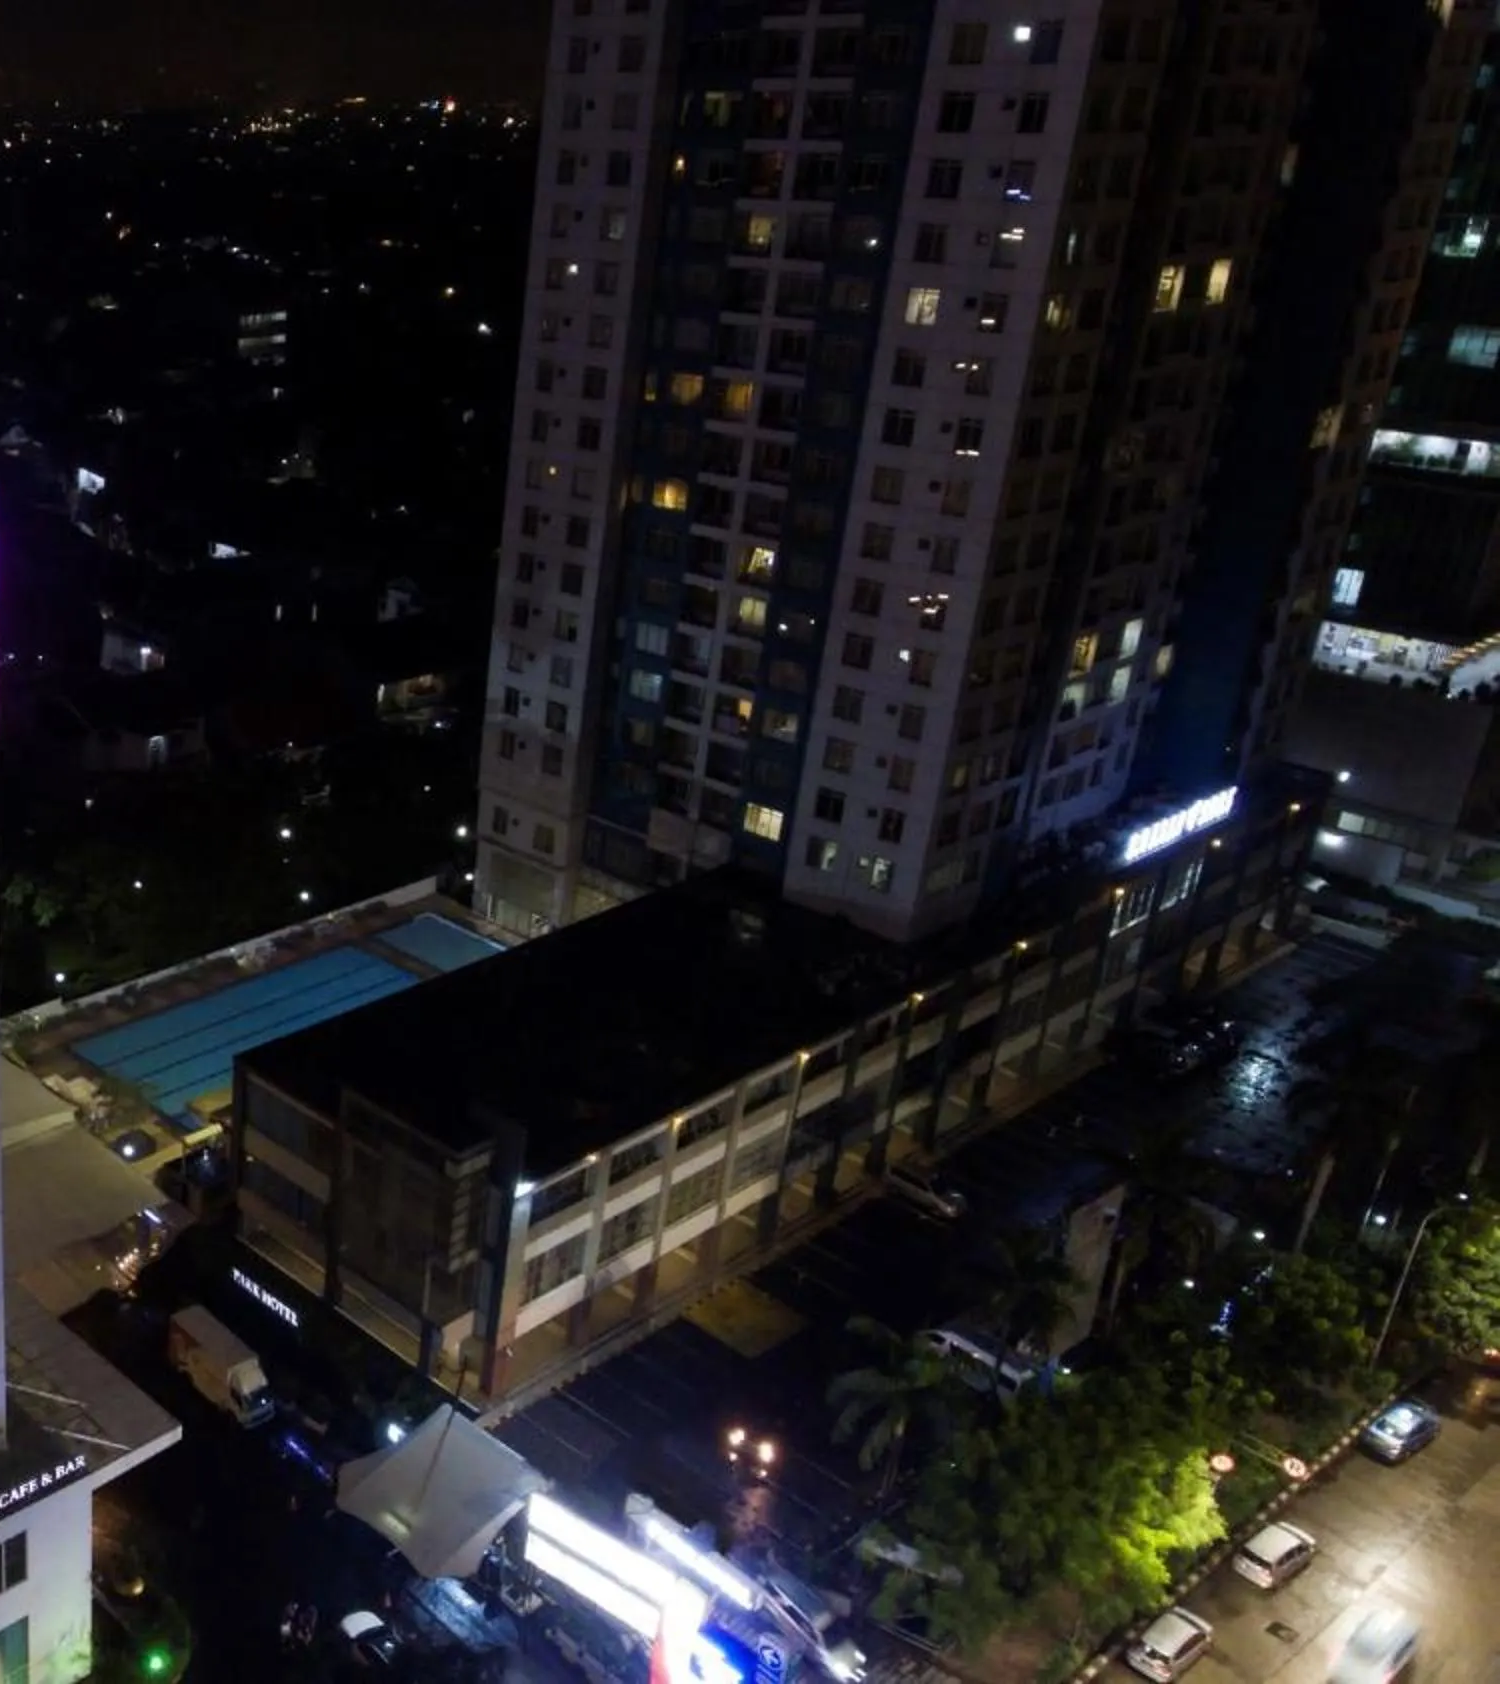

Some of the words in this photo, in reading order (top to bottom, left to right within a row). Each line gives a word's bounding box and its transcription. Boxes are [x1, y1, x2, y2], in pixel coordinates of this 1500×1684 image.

[261, 1288, 299, 1327] HOTEL
[41, 1472, 53, 1488] &
[54, 1454, 87, 1480] BAR
